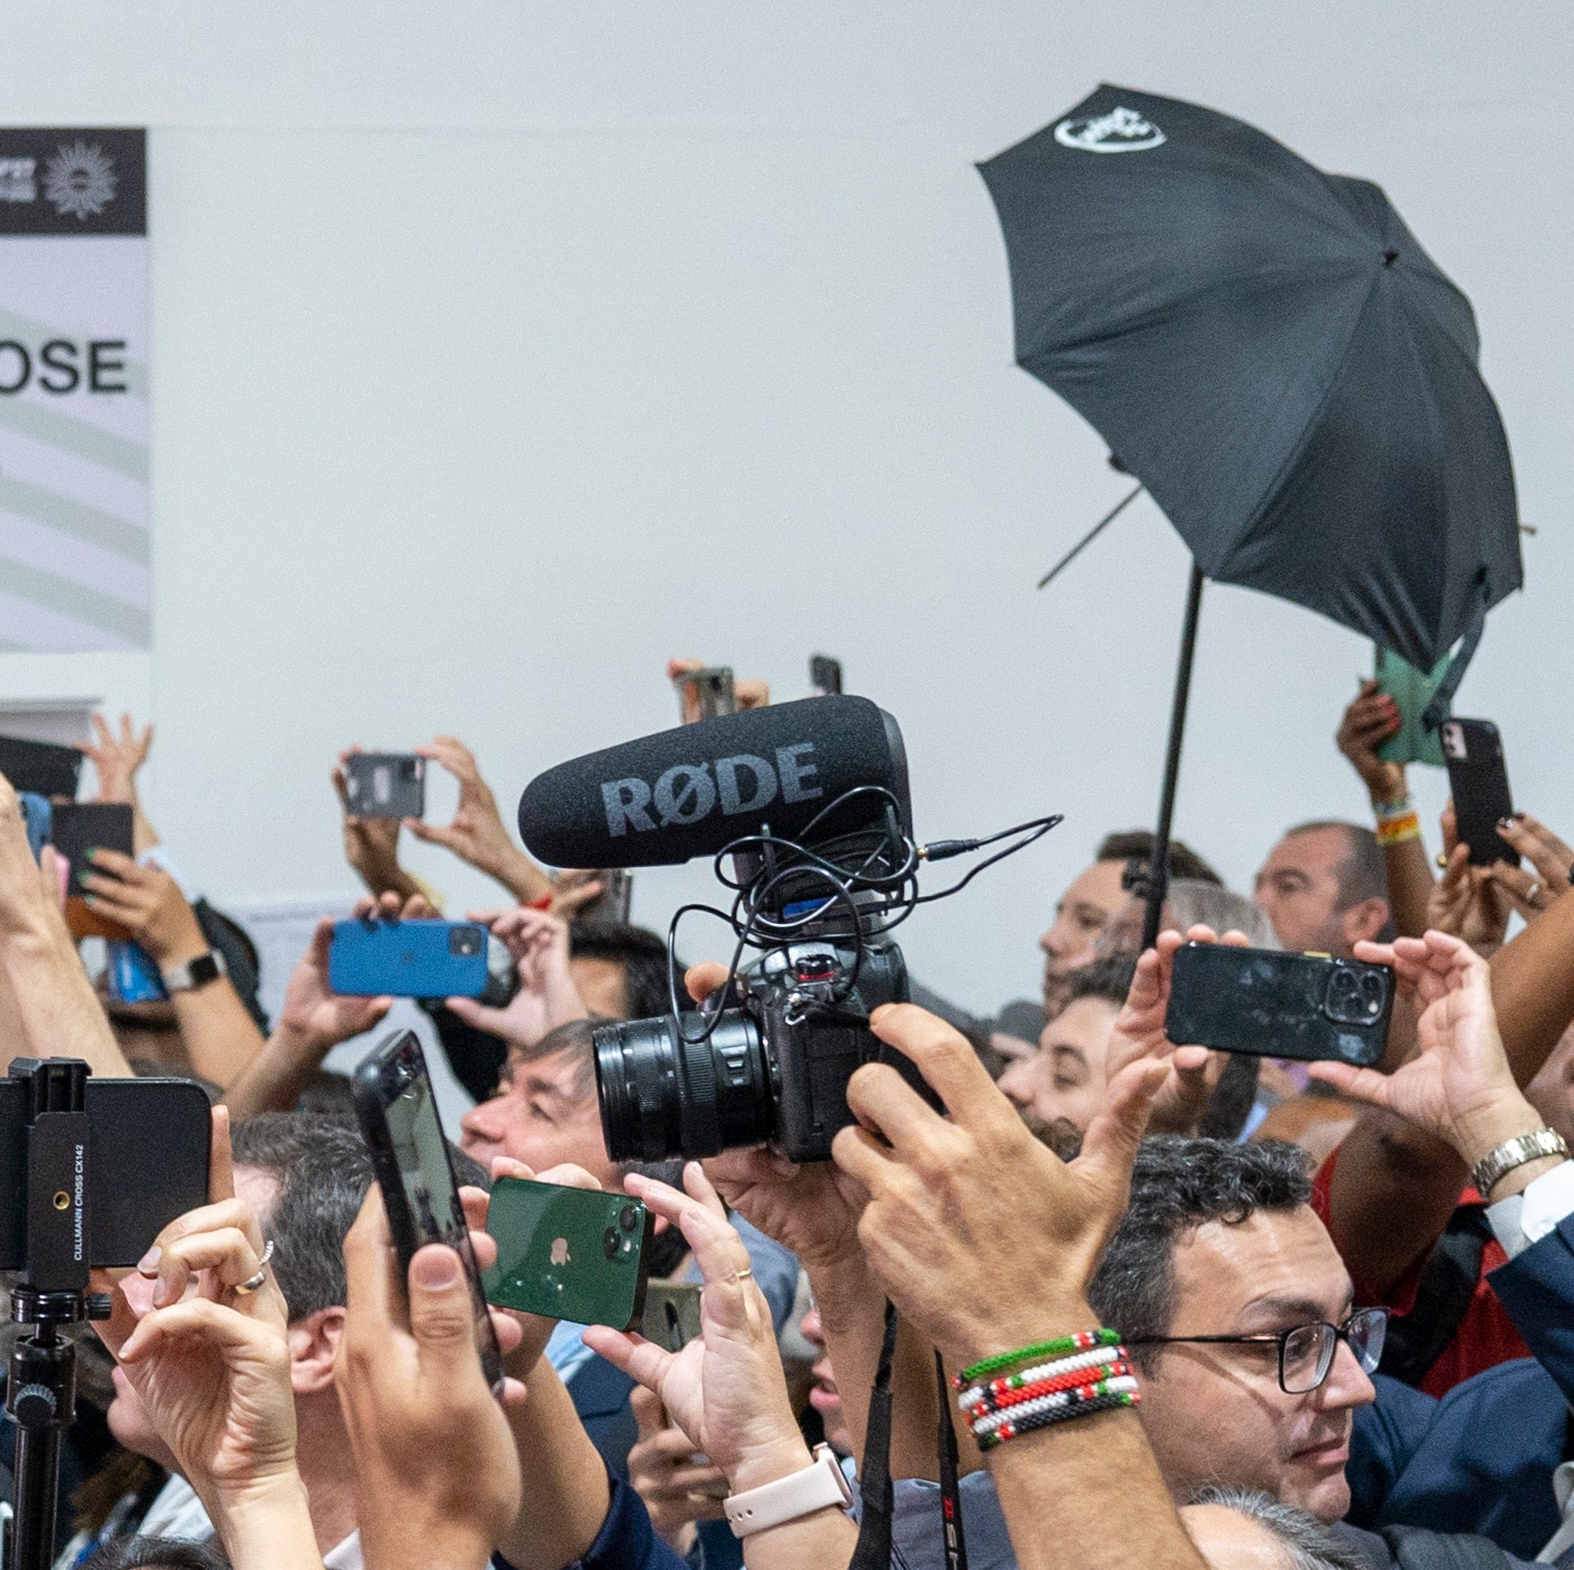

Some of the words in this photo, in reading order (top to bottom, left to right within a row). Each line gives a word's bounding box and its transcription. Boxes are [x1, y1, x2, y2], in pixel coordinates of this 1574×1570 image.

[600, 741, 824, 838] RØDE
[75, 1144, 84, 1173] CX142
[74, 1174, 84, 1207] CROSS
[73, 1207, 84, 1261] CULLMANN
